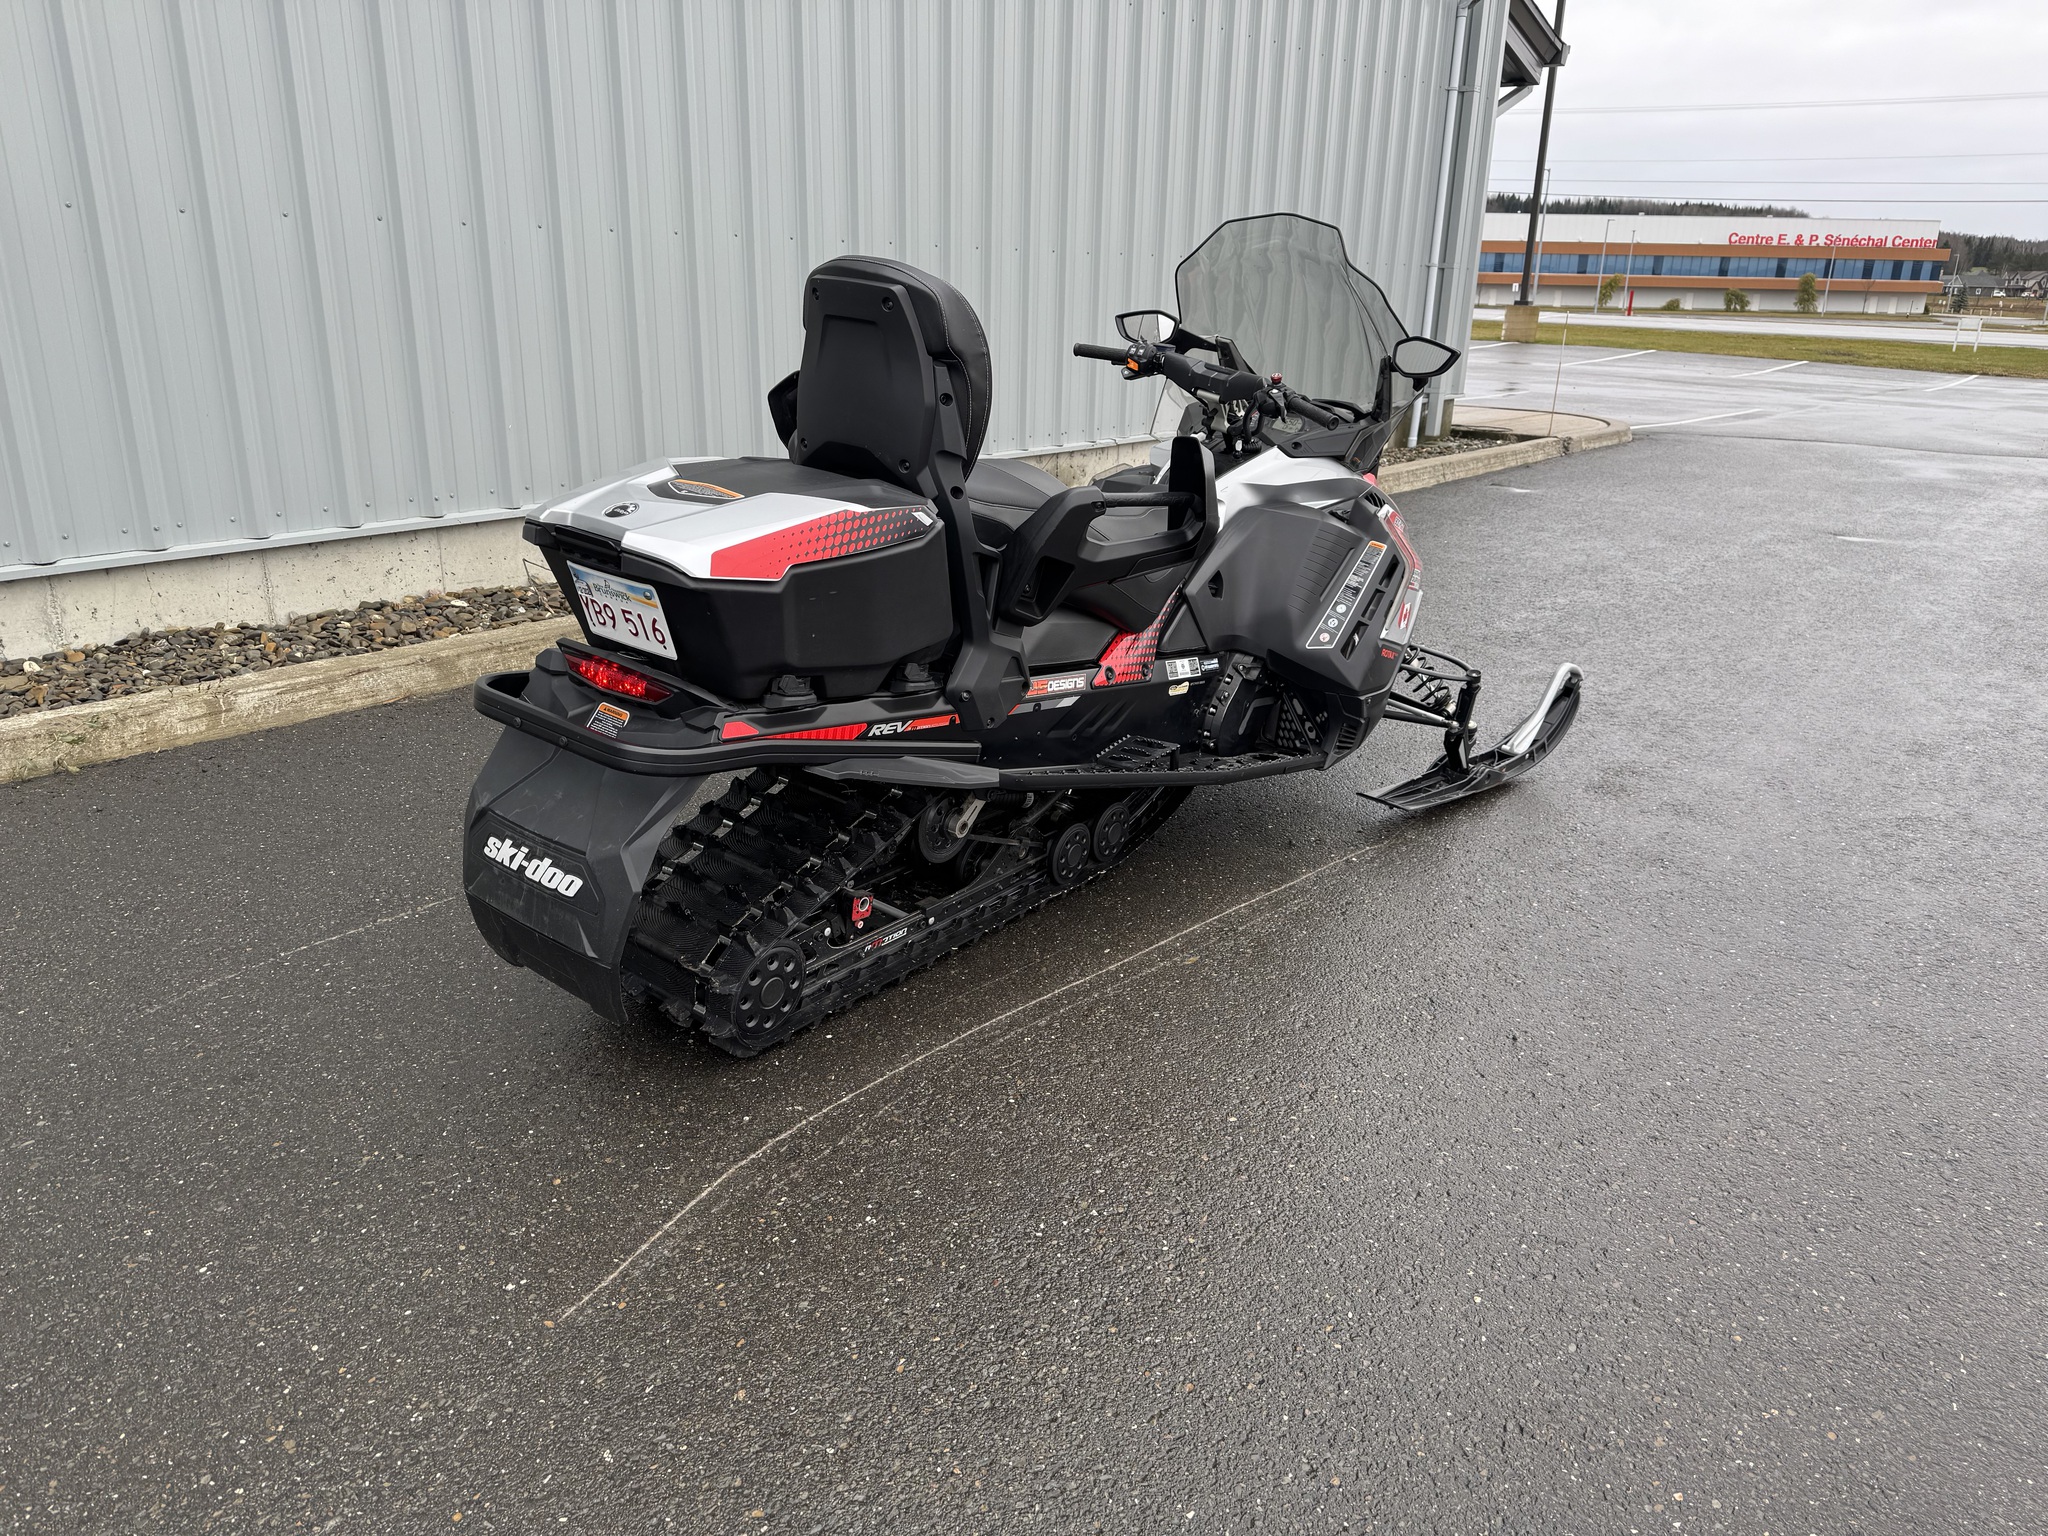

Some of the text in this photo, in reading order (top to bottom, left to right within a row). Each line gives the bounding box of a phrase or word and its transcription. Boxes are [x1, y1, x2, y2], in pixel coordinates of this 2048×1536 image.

[1728, 232, 1938, 249] Centre E. & P. Sénéchal Center
[580, 594, 666, 646] YB9 516
[868, 720, 914, 738] REV
[483, 836, 584, 898] ski-doo
